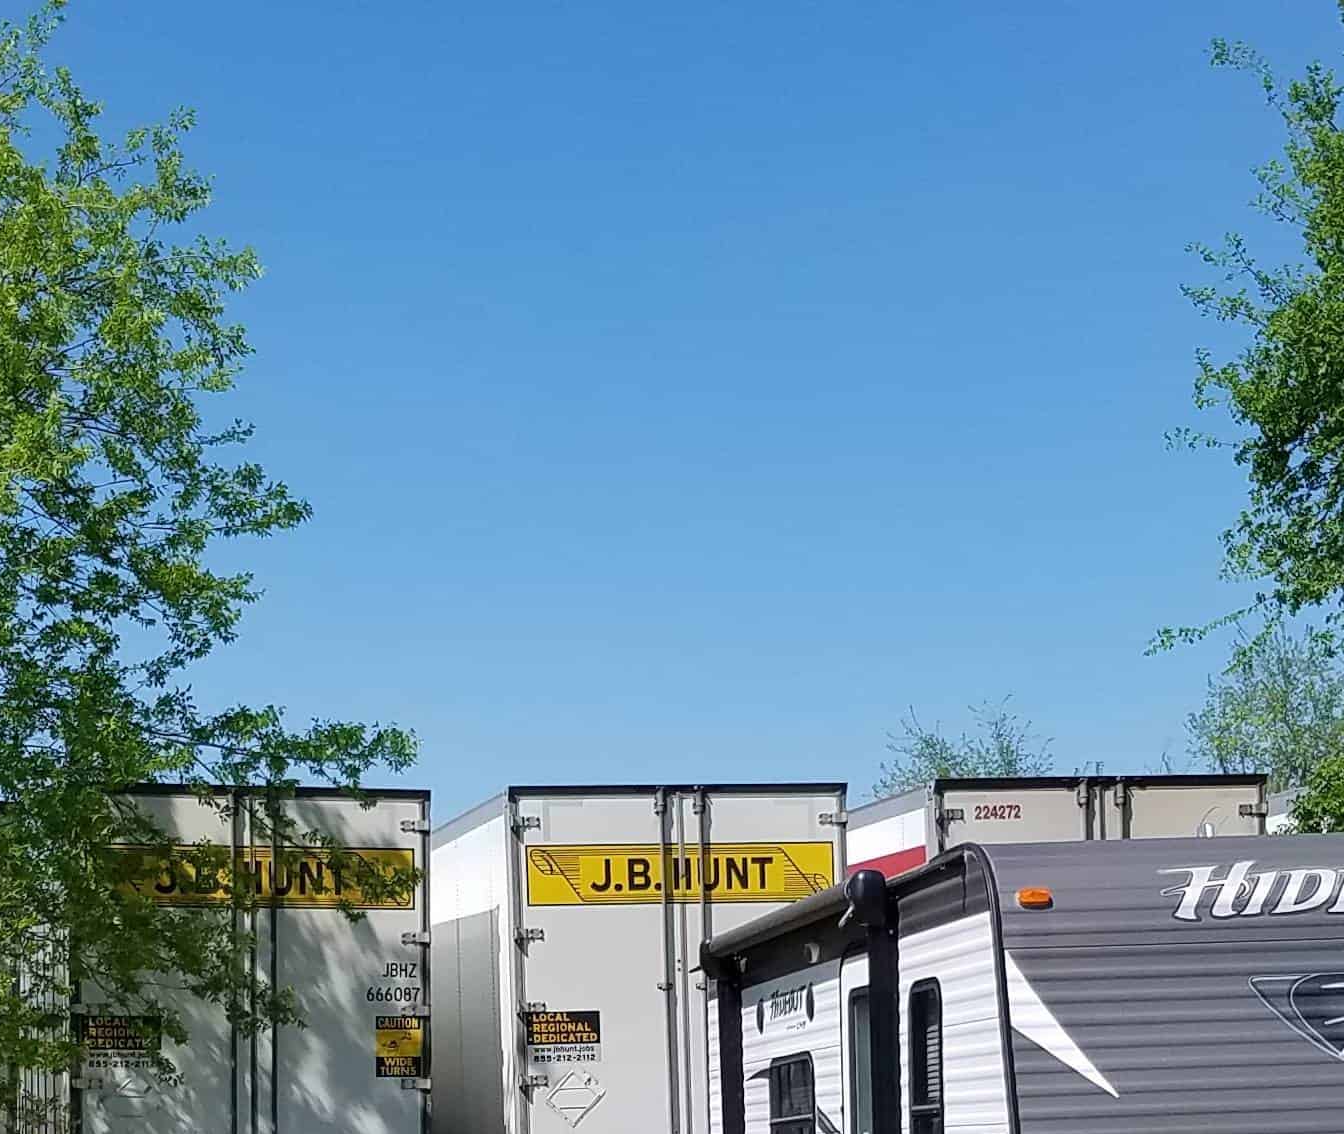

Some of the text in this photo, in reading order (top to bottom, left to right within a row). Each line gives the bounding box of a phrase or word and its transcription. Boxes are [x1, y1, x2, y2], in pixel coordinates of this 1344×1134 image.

[974, 804, 1022, 820] 224272
[590, 856, 774, 892] J.B. HUNT
[382, 962, 418, 978] JBHZ
[366, 986, 421, 1002] 666087
[88, 1017, 128, 1026] LOCAL
[532, 1013, 570, 1022] LOCAL
[377, 1017, 419, 1029] CAUTION
[532, 1022, 592, 1032] REGIONAL
[88, 1027, 147, 1037] REGION
[532, 1033, 598, 1043] DEDICATED
[88, 1039, 153, 1048] DEDICAT
[88, 1060, 153, 1068] 855-212-211
[383, 1057, 413, 1066] WIDE
[379, 1067, 417, 1076] TURNS
